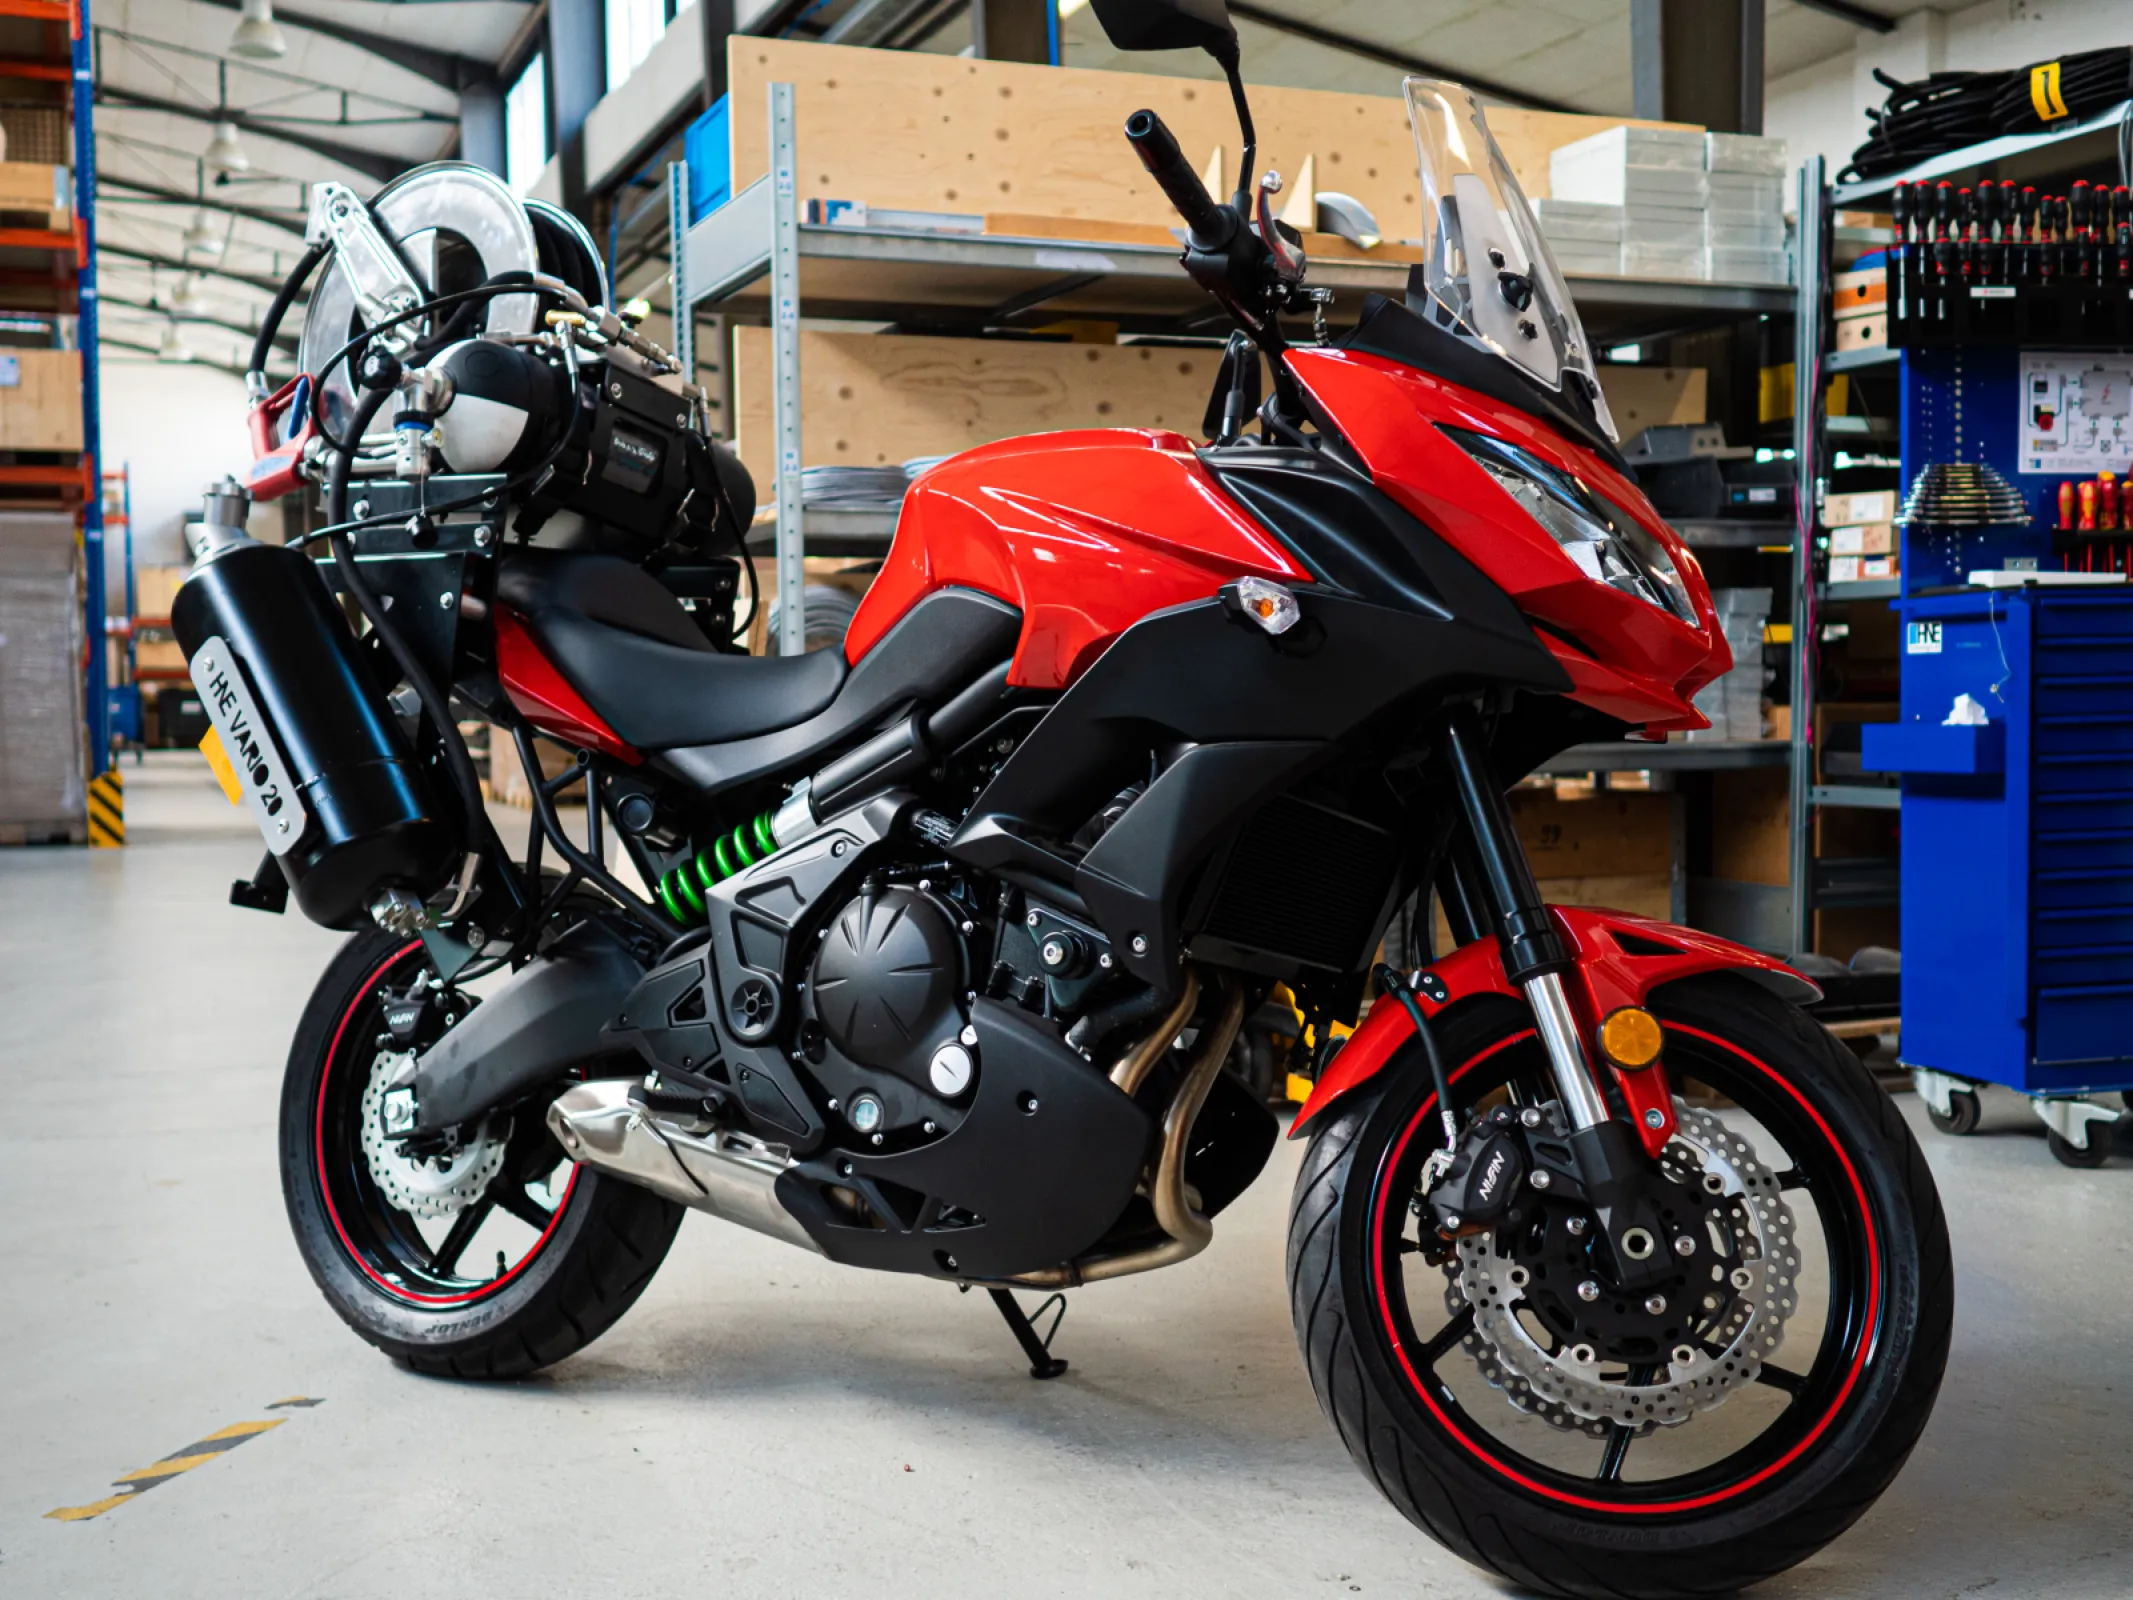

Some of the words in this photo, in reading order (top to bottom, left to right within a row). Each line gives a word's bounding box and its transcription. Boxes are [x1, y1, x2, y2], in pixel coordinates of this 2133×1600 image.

[1917, 622, 1941, 645] HNE
[209, 671, 237, 717] HNE
[230, 709, 270, 787] VARIO
[260, 784, 283, 816] 20
[424, 1310, 494, 1334] DUNLOP
